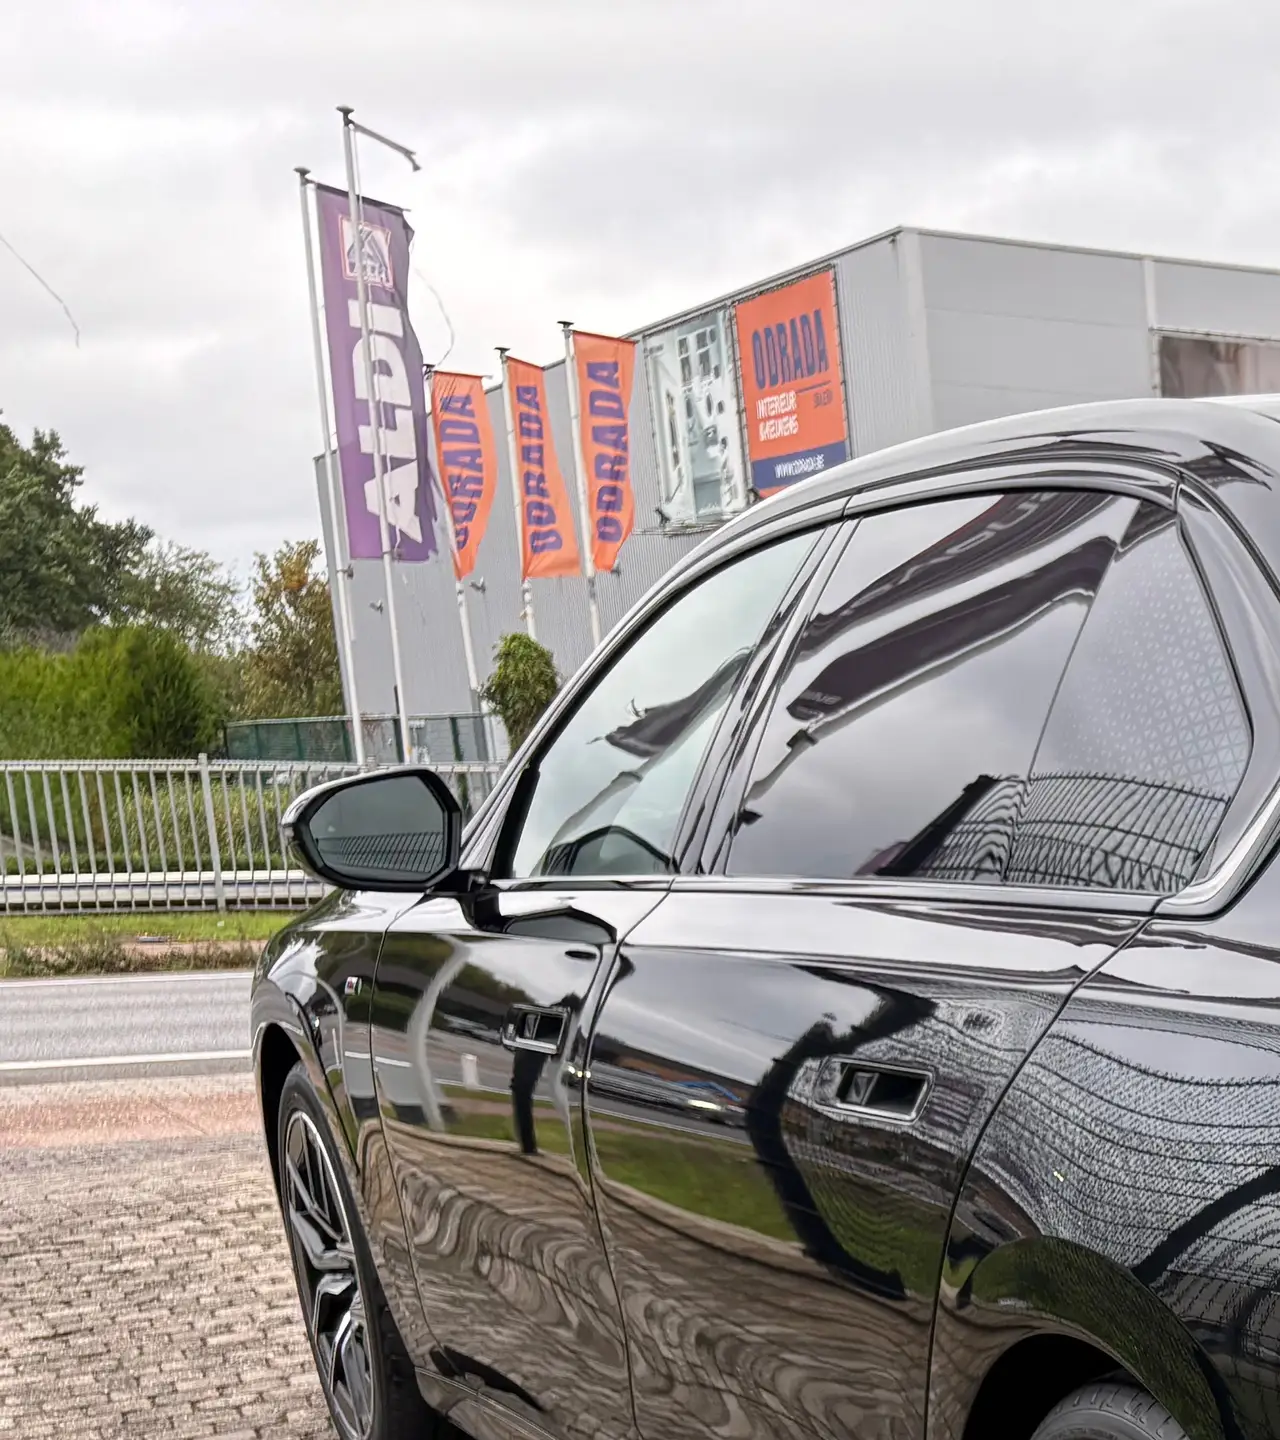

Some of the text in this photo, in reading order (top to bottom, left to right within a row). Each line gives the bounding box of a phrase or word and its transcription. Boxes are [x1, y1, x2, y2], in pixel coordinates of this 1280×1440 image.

[347, 299, 422, 543] ALDI
[752, 308, 830, 391] ODRADA
[516, 386, 563, 554] ODRADA
[586, 361, 629, 543] ODRADA
